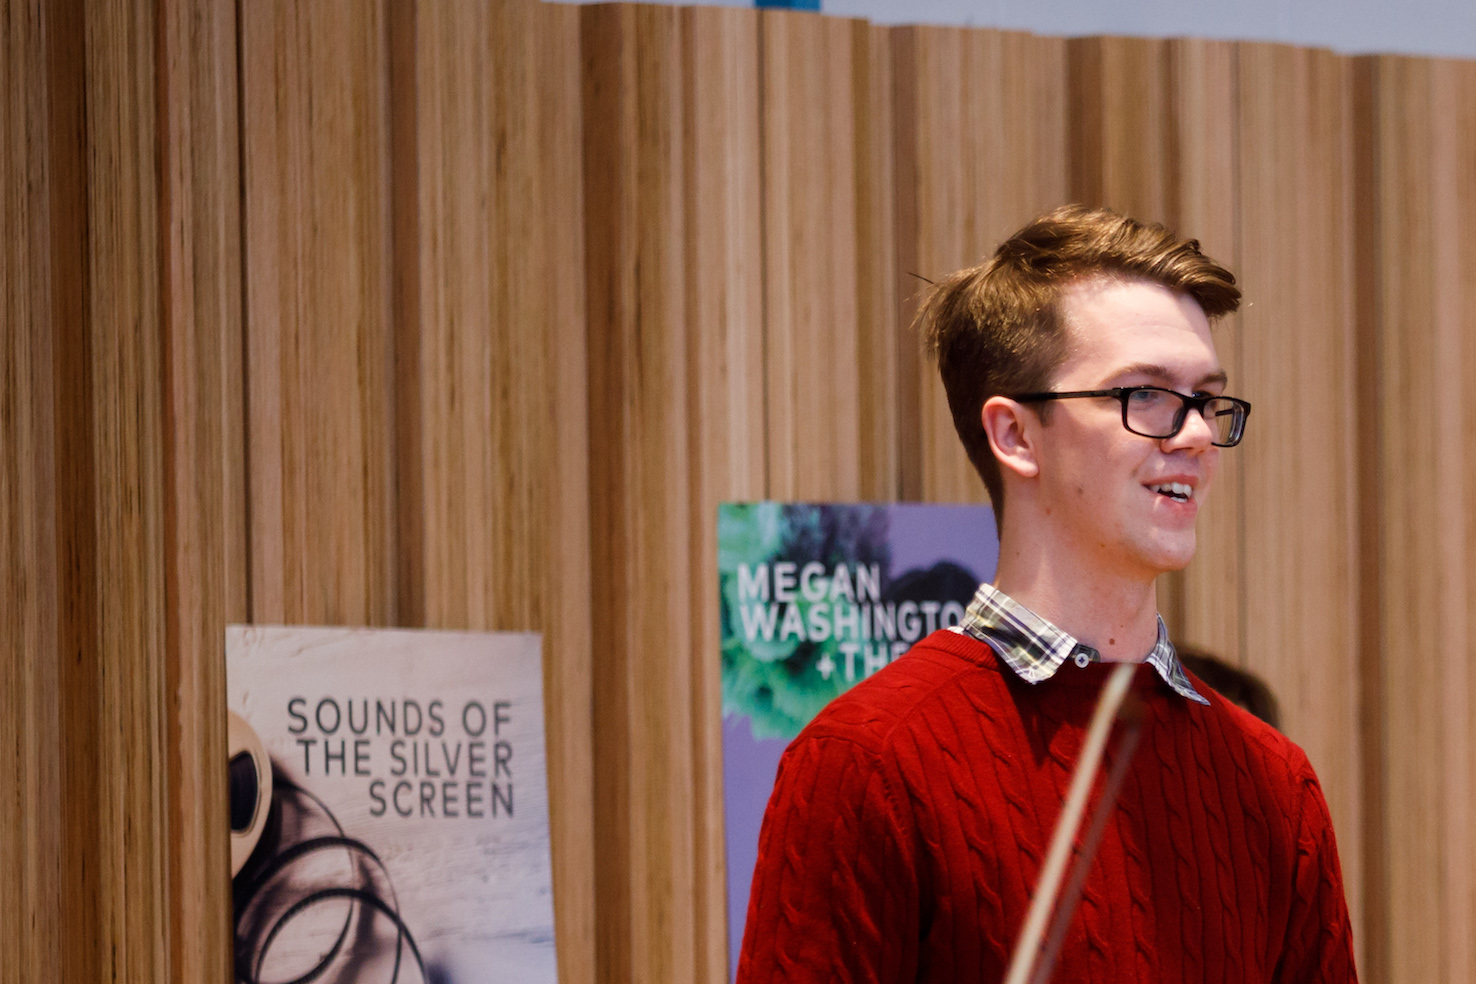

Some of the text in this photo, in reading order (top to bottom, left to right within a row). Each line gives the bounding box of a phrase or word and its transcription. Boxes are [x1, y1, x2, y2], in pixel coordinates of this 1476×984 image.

[737, 561, 880, 602] MEGAN
[287, 697, 512, 737] SOUNDS OF
[297, 738, 513, 778] THE SILVER
[369, 780, 515, 818] SCREEN
